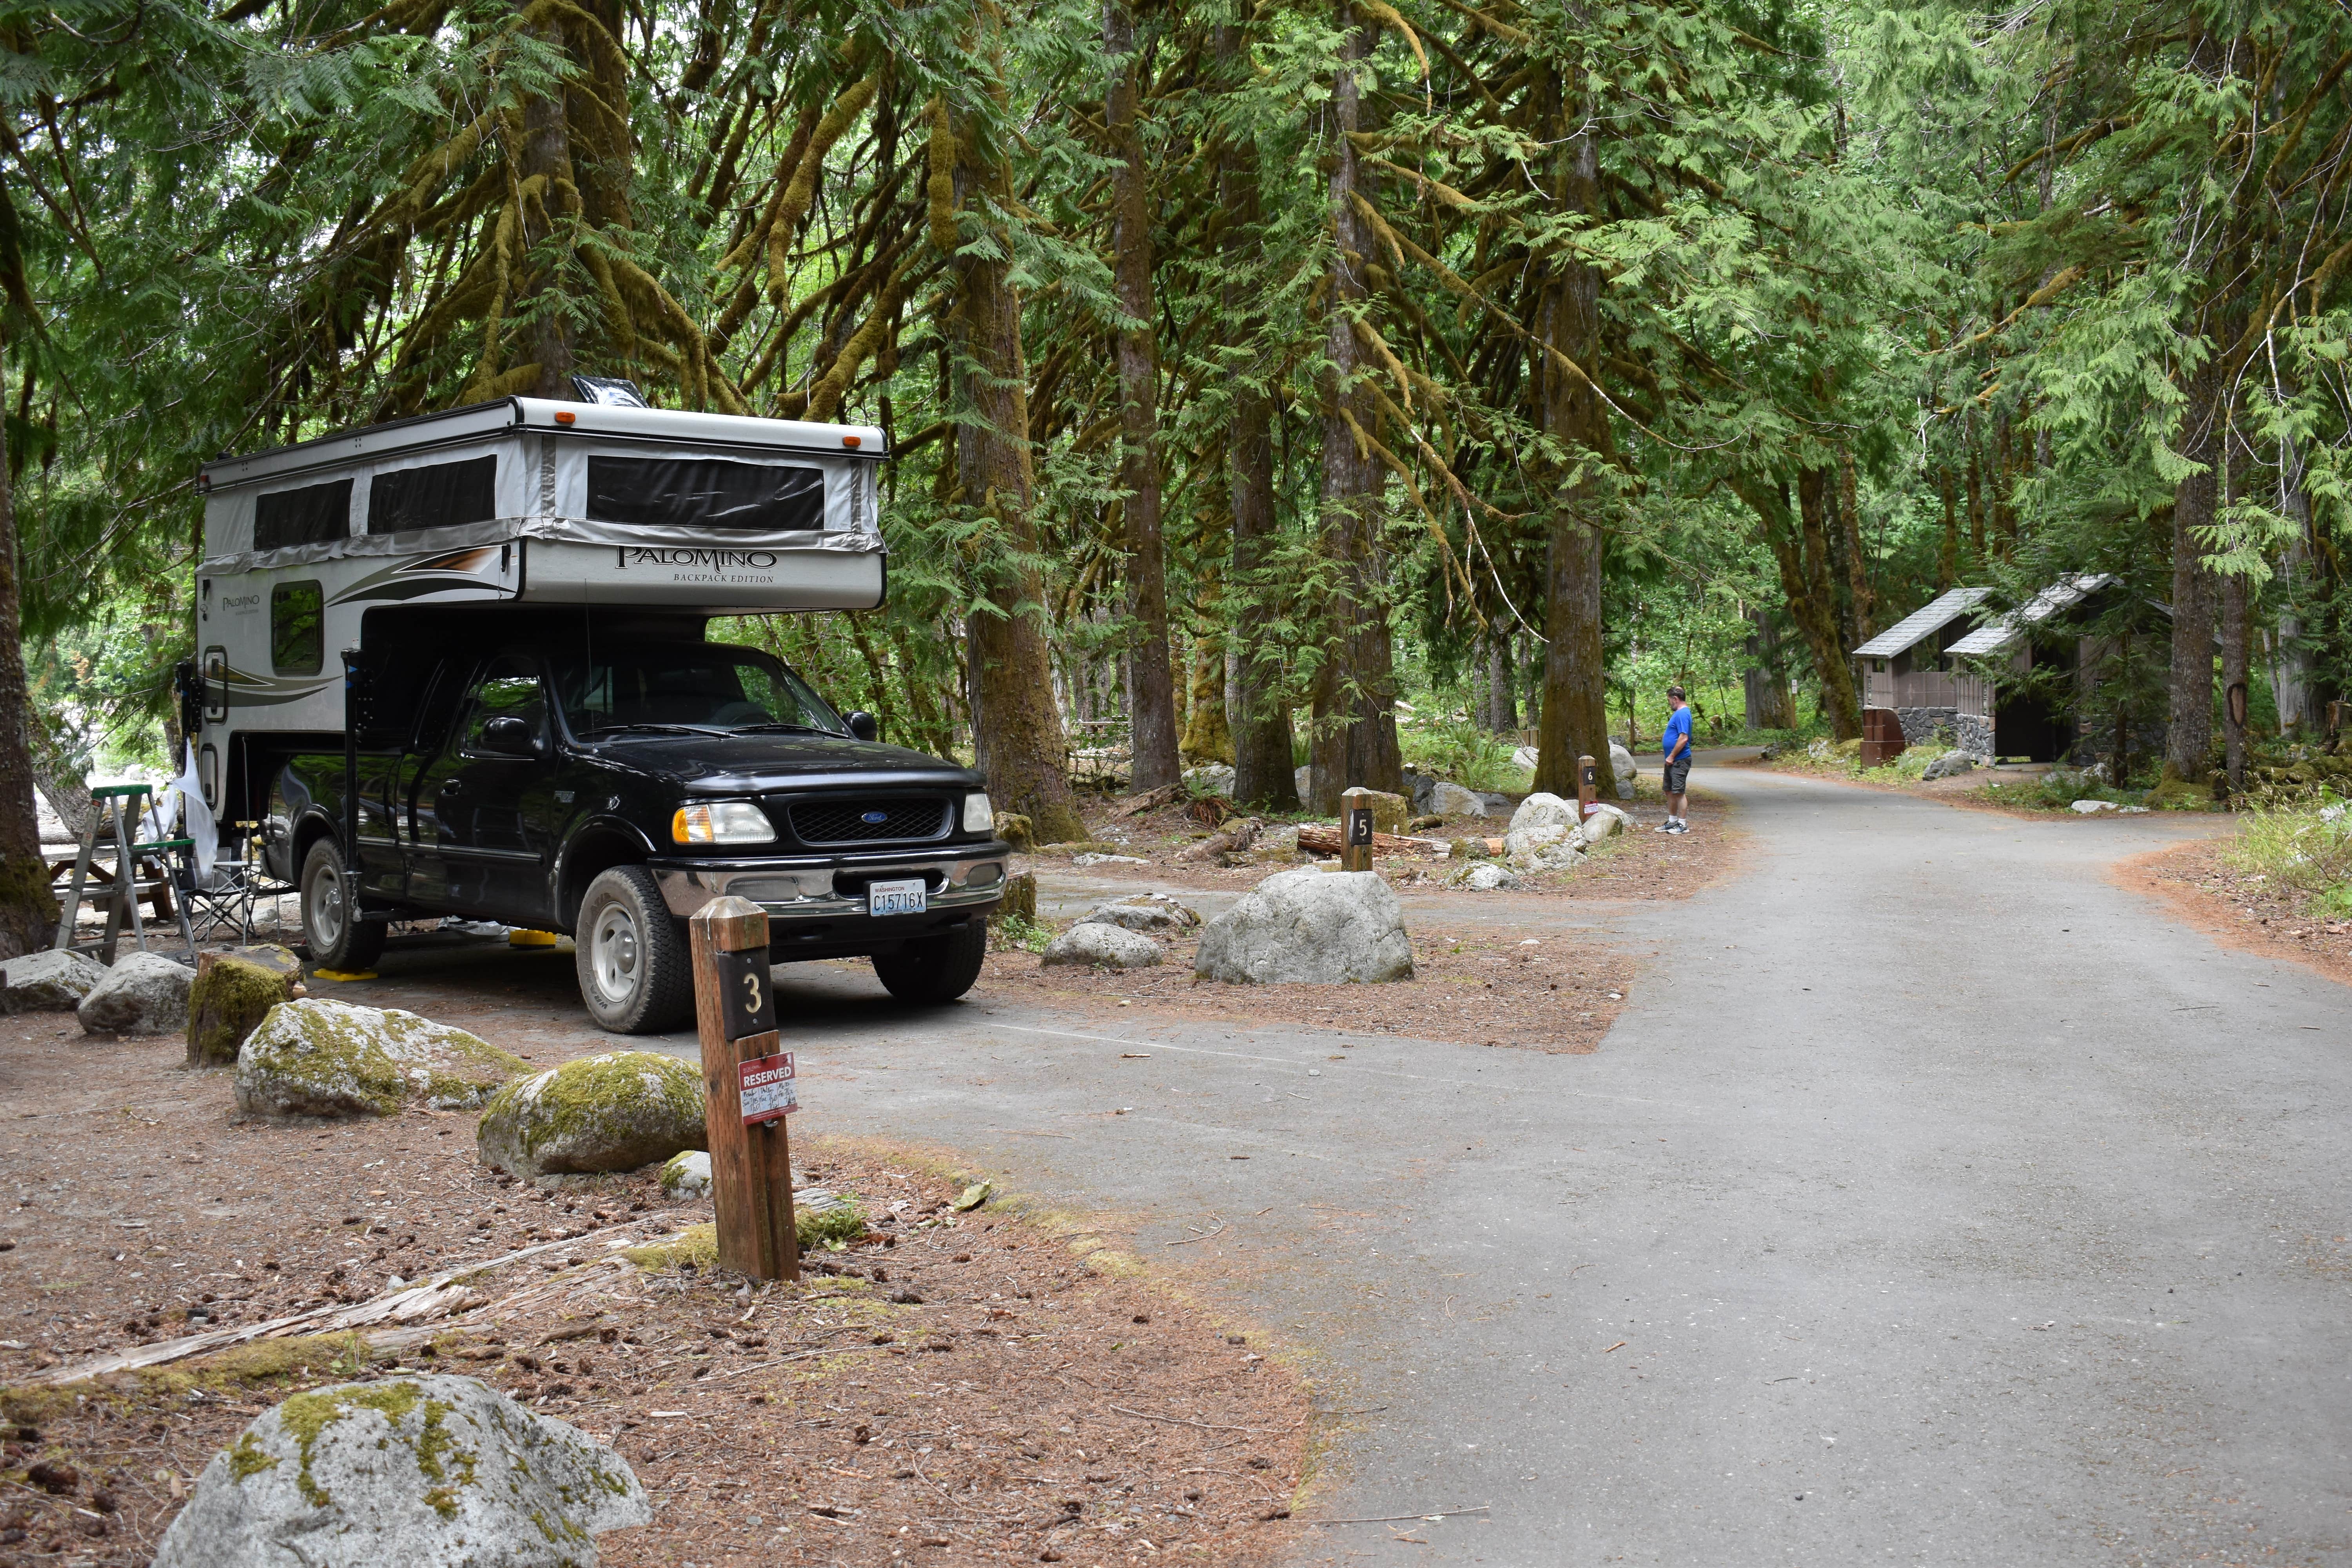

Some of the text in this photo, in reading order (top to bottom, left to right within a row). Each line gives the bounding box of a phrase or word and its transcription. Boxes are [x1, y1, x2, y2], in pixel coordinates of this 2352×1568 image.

[615, 546, 778, 573] PALOMINO
[223, 595, 260, 611] PALOMINO
[1588, 771, 1593, 780] 6
[1359, 819, 1367, 836] 5
[874, 891, 923, 911] C15716X
[744, 973, 762, 1013] 3
[744, 1066, 792, 1087] RESERVED
